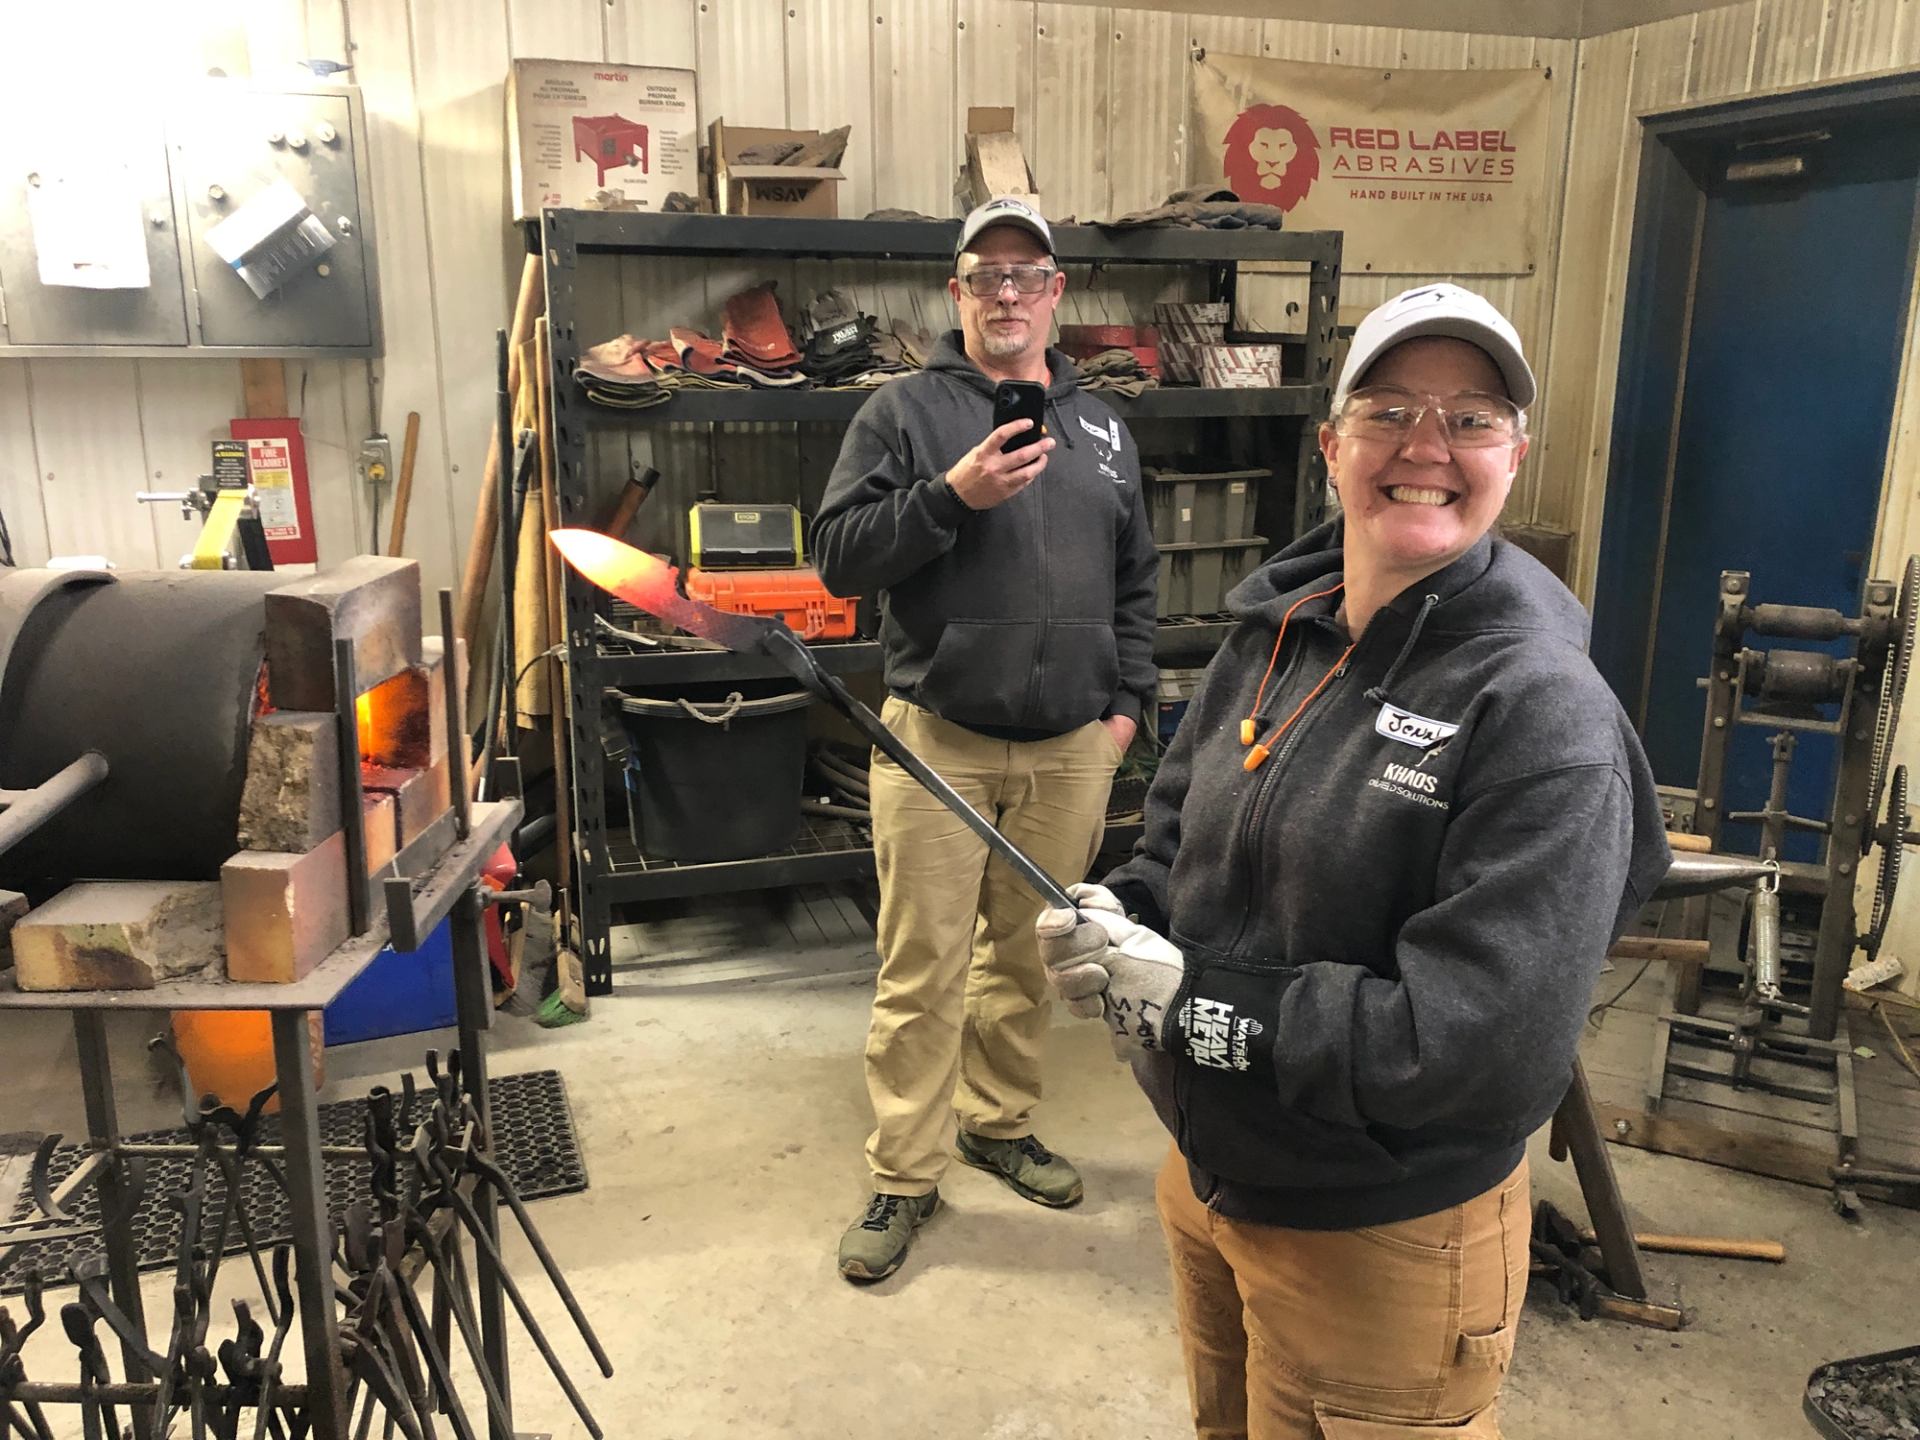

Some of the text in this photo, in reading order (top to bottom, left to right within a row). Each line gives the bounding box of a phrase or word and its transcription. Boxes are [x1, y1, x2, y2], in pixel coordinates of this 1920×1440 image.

[594, 71, 629, 82] martin
[648, 92, 676, 100] PROPANE
[1329, 127, 1516, 152] RED LABEL
[1333, 154, 1515, 176] ABRASIVES
[1350, 190, 1493, 202] HAND BUILT IN THE USA
[1383, 762, 1438, 793] KHAOS
[1396, 785, 1449, 810] SOLUTIONS
[1189, 997, 1214, 1068] METAL
[1210, 1001, 1234, 1072] HEAVY
[1237, 1018, 1251, 1071] WATSON
